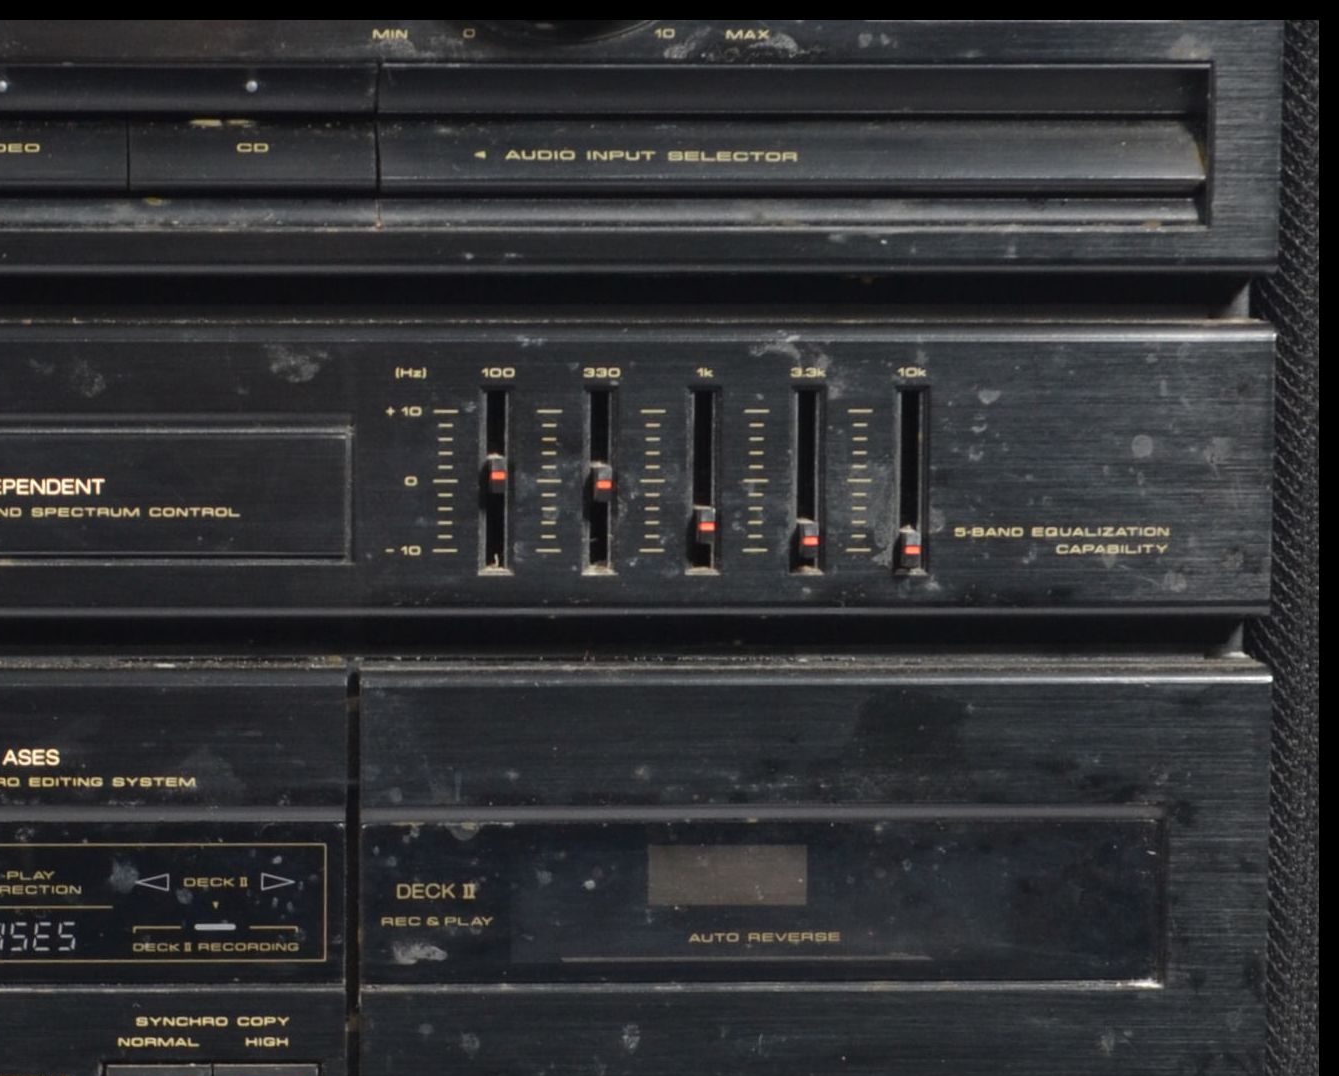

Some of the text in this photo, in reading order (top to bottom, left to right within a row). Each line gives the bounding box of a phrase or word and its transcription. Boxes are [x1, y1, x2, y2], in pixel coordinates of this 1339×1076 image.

[372, 29, 408, 39] MIN
[726, 29, 770, 39] MAX
[237, 143, 269, 152] CD
[505, 150, 797, 162] AUDIO INPUT SELECTOR
[31, 507, 140, 517] SPECTRUM
[149, 507, 240, 517] CONTROL
[954, 527, 1170, 537] 5-BAND EQUALIZATION
[1056, 544, 1168, 556] CAPABILITY
[3, 749, 60, 765] ASES
[29, 777, 103, 787] EDITING
[112, 777, 196, 787] SYSTEM
[7, 871, 54, 880] PLAY
[184, 878, 234, 888] DECK
[397, 883, 455, 899] DECK
[381, 917, 492, 926] REC & PLAY
[689, 932, 840, 944] AUTO REVERSE
[133, 942, 179, 952] DECK
[198, 943, 299, 951] RECORDING
[136, 1017, 289, 1026] SYNCHRO COPY
[118, 1037, 199, 1047] NORMAL
[245, 1037, 288, 1047] HIGH
